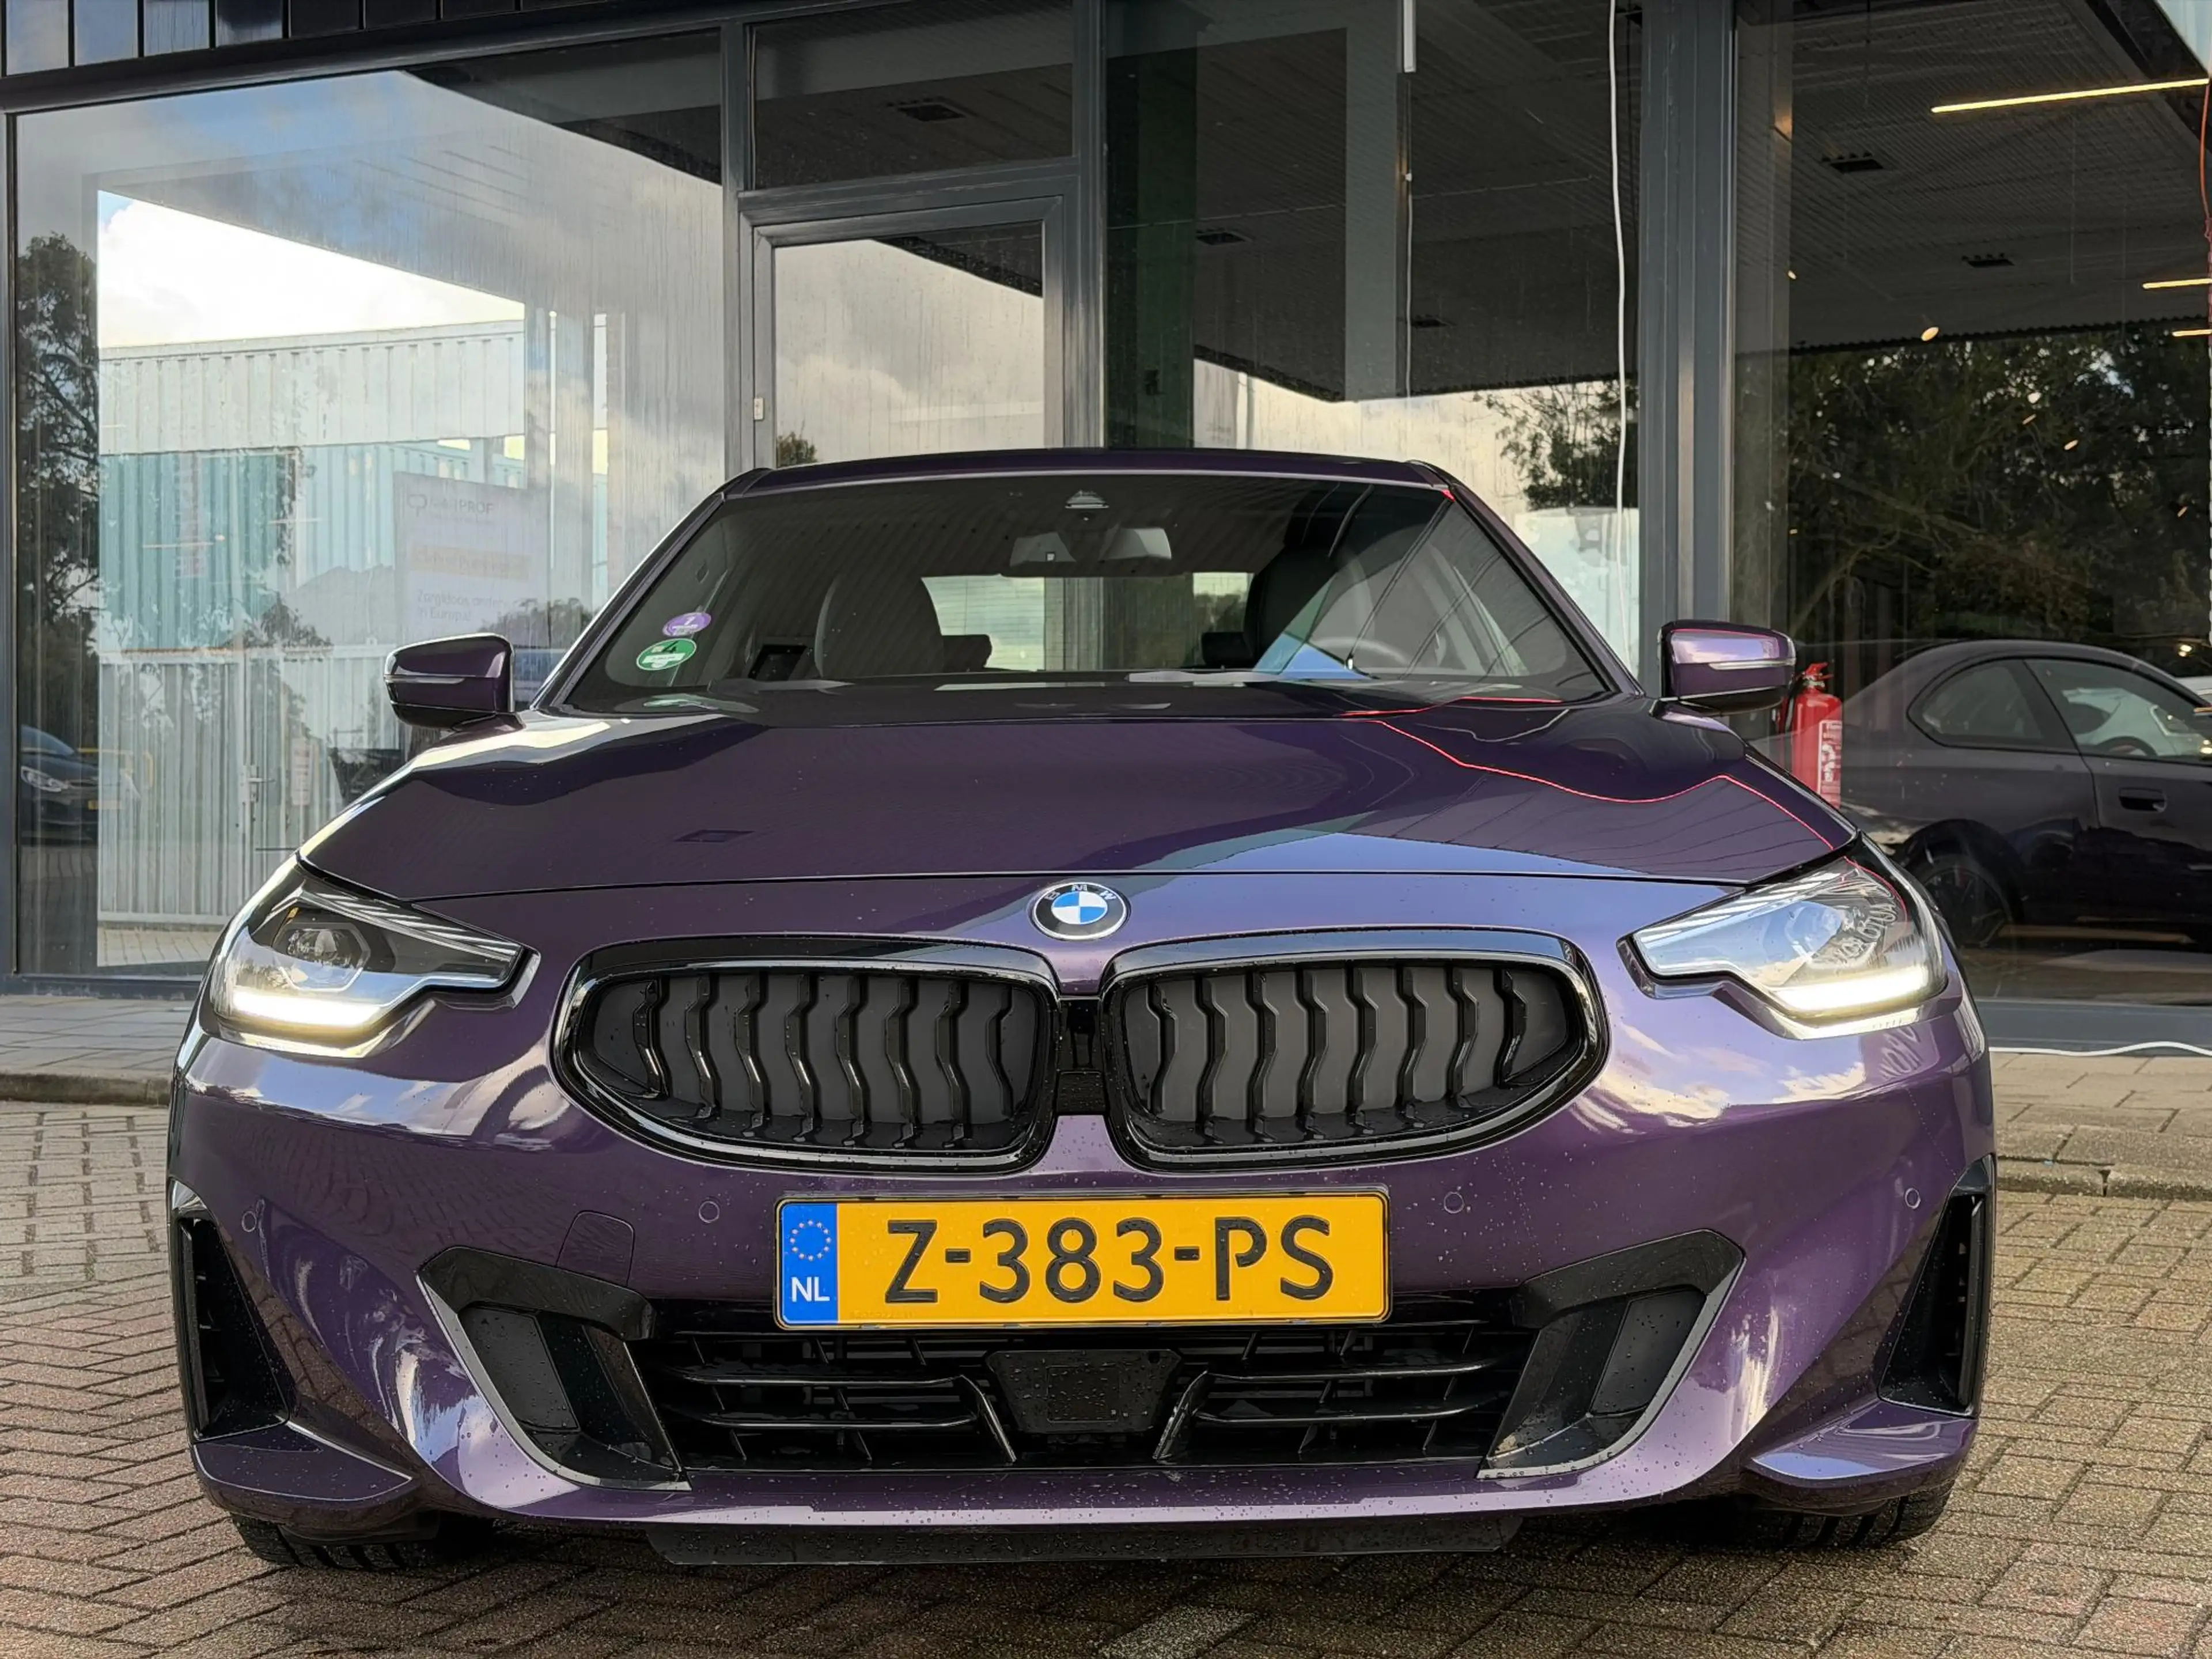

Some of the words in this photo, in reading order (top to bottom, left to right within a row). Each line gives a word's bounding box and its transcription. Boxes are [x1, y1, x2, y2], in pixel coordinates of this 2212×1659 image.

[1044, 884, 1116, 901] BMW
[884, 1216, 1334, 1304] Z-383-PS
[791, 1275, 830, 1303] NL
